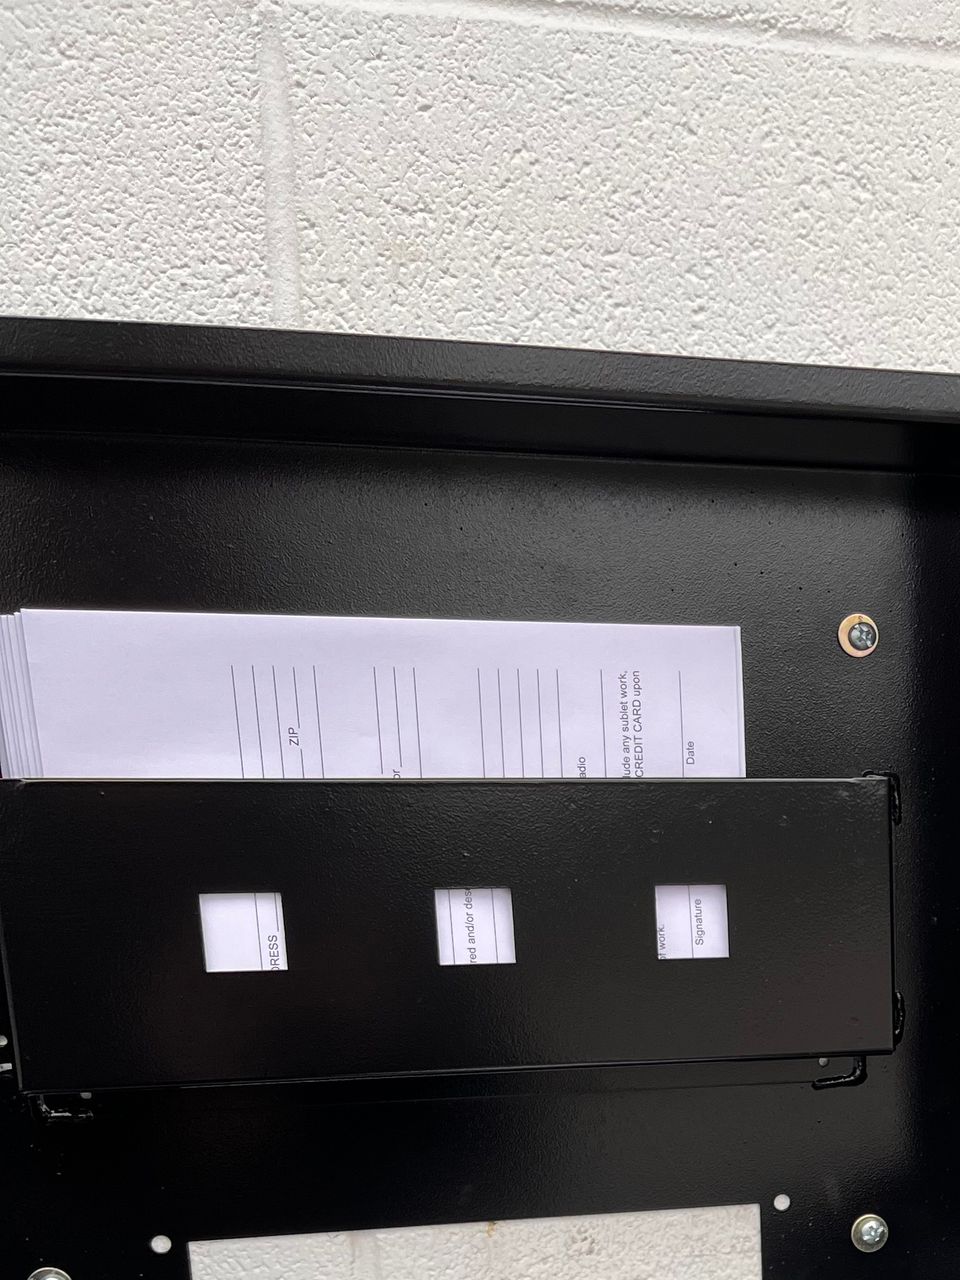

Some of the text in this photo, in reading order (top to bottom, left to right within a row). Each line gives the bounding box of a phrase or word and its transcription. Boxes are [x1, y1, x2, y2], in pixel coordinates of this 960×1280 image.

[618, 670, 629, 699] work,
[620, 702, 629, 732] sublet
[633, 670, 644, 778] CREDIT CARD upon
[288, 727, 299, 746] ZIP
[622, 735, 632, 754] any
[686, 740, 695, 765] Date
[465, 912, 475, 944] and/or
[695, 898, 705, 946] Signature
